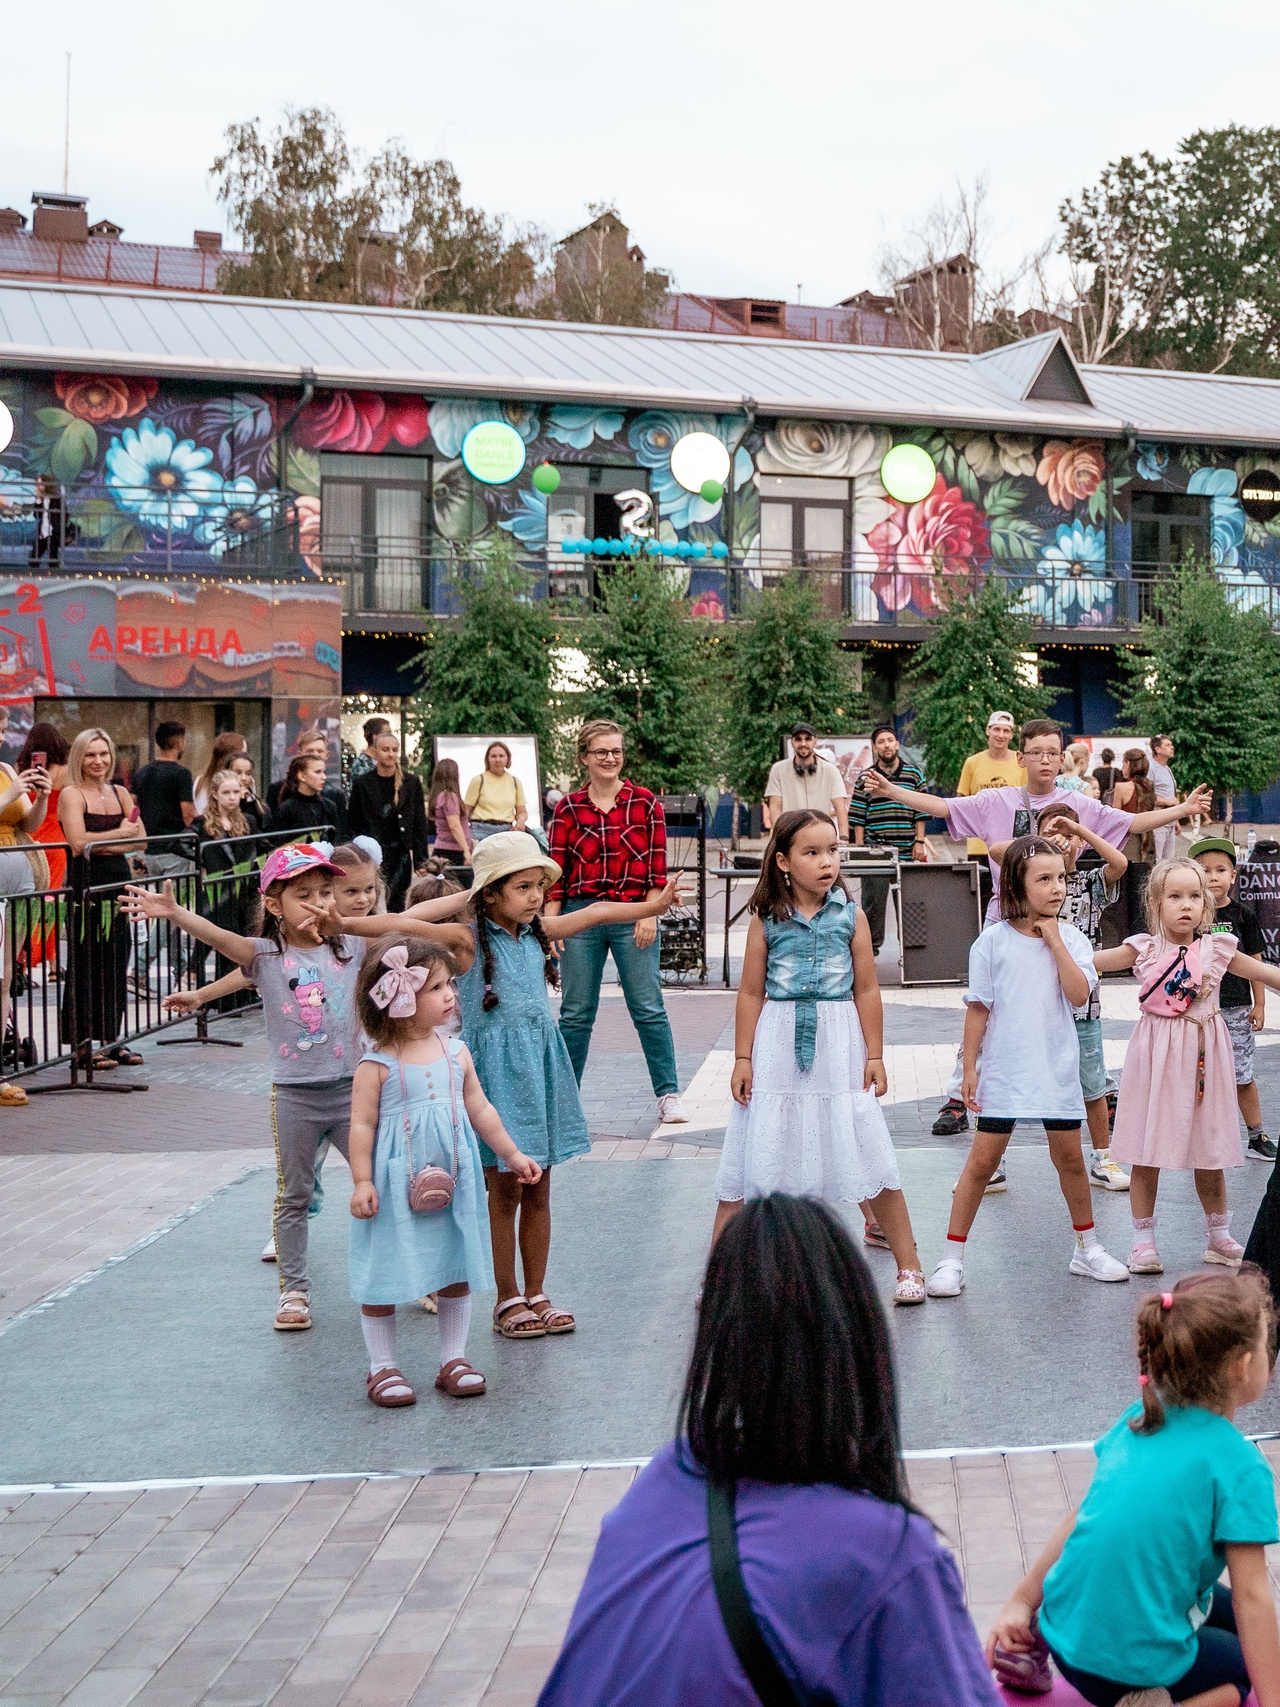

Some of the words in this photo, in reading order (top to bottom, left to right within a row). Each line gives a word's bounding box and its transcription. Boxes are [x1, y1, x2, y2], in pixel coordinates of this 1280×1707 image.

[475, 437, 513, 448] MAYBE
[475, 449, 514, 460] DANCE
[88, 625, 243, 659] АРЕНДА
